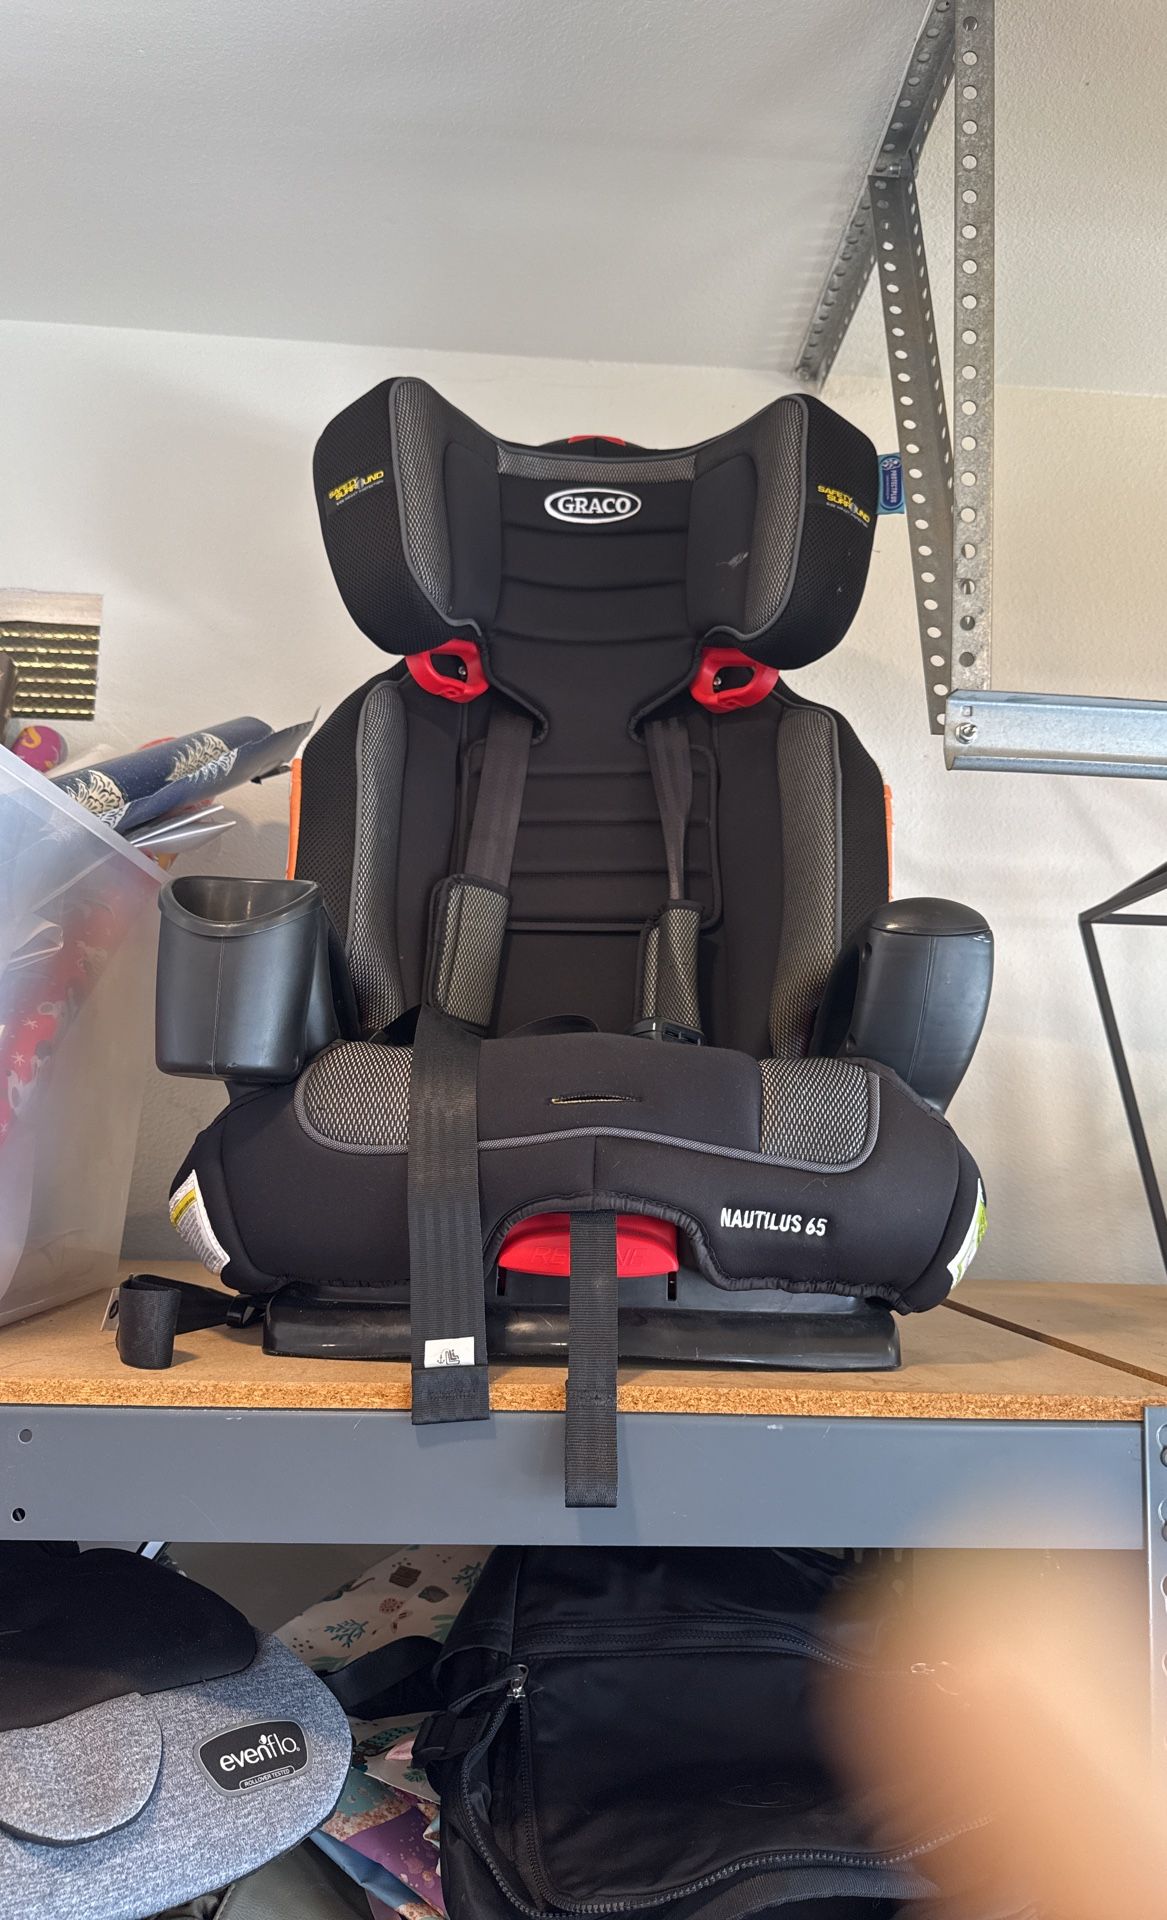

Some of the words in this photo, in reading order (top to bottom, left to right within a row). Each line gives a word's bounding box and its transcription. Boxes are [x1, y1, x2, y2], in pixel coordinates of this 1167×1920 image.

[817, 485, 853, 503] SAFETY
[557, 496, 631, 514] GRACO
[720, 1207, 802, 1233] NAUTILUS
[805, 1217, 828, 1237] 65
[219, 1733, 297, 1772] evenflo
[244, 1774, 272, 1788] ROLLOVER
[272, 1767, 291, 1780] TESTED
